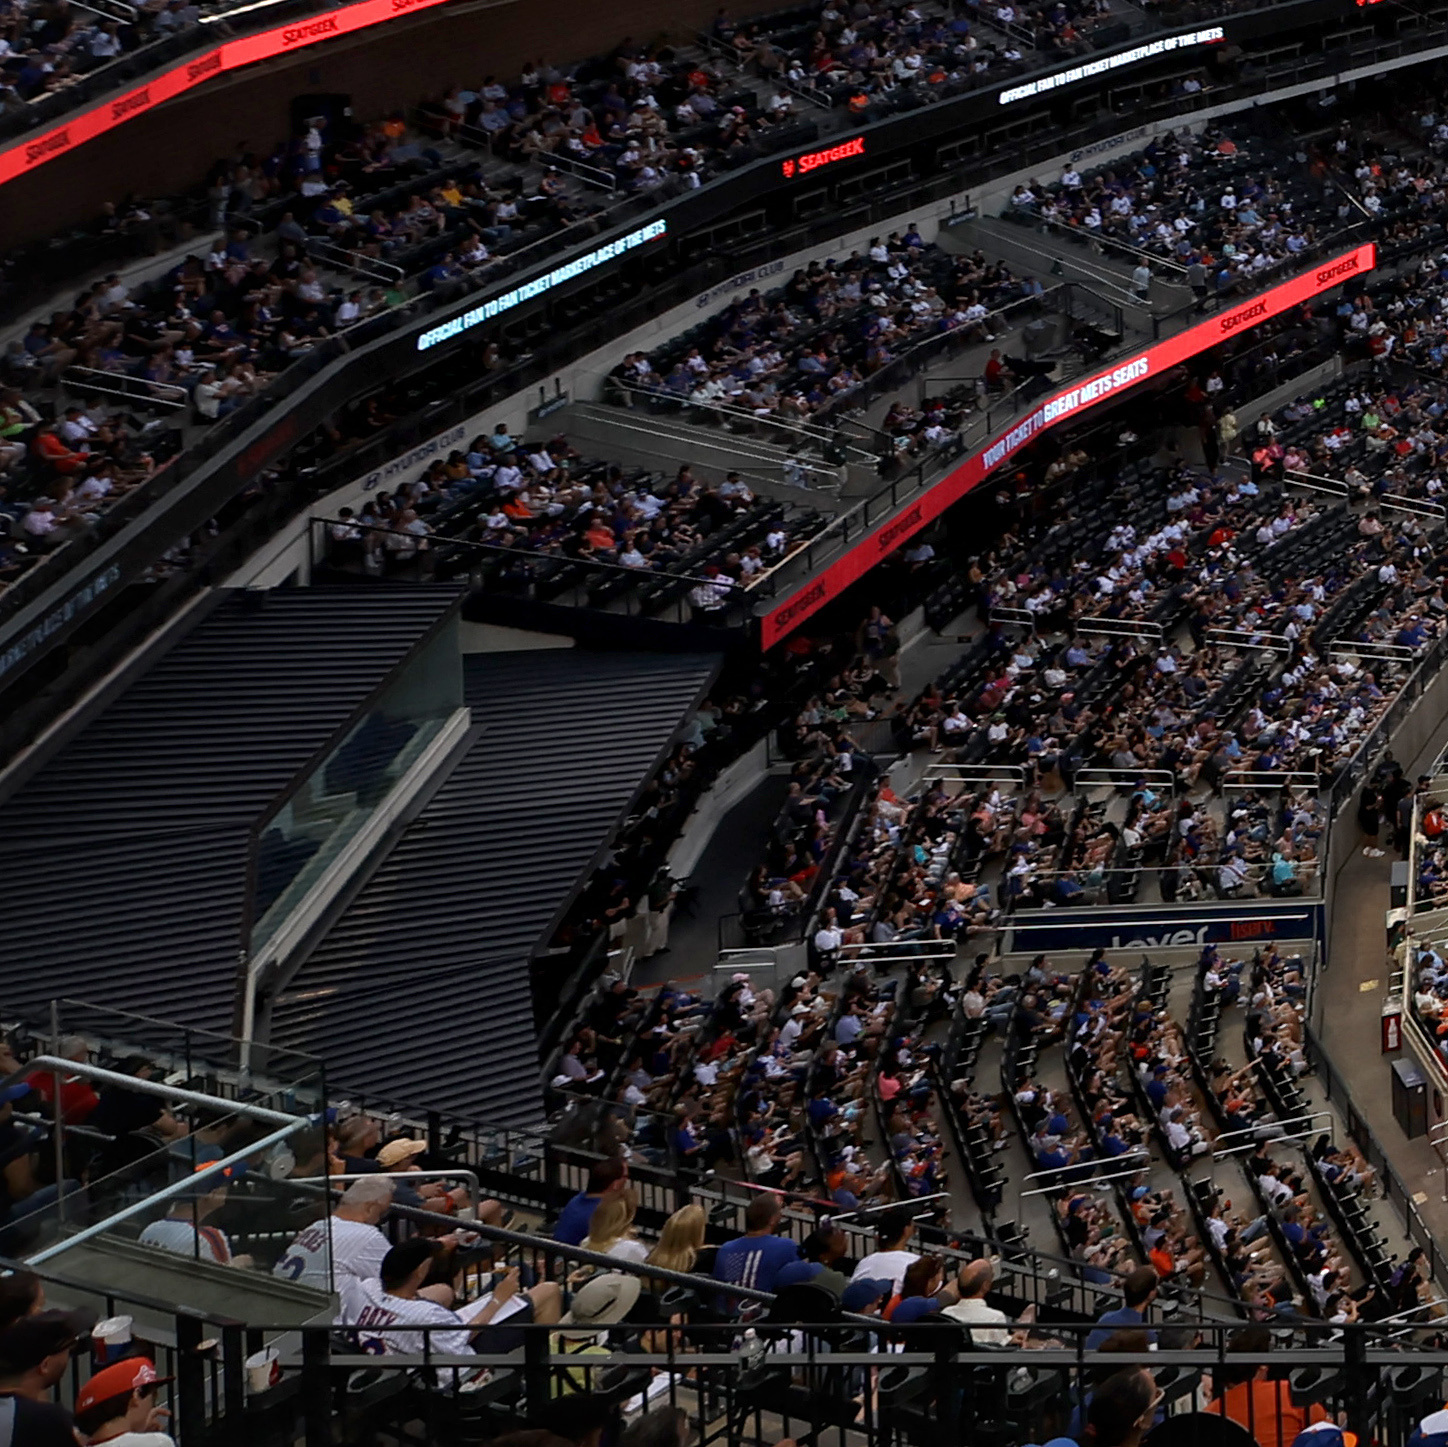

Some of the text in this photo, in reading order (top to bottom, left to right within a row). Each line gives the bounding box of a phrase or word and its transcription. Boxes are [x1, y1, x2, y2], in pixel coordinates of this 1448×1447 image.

[281, 14, 339, 46] SEATGEEK
[798, 136, 866, 173] SEATGEEK
[1316, 255, 1359, 287] SEATGEEK
[1220, 299, 1268, 334] SEATGEEK
[1044, 357, 1148, 423] GREAT METS SEATS
